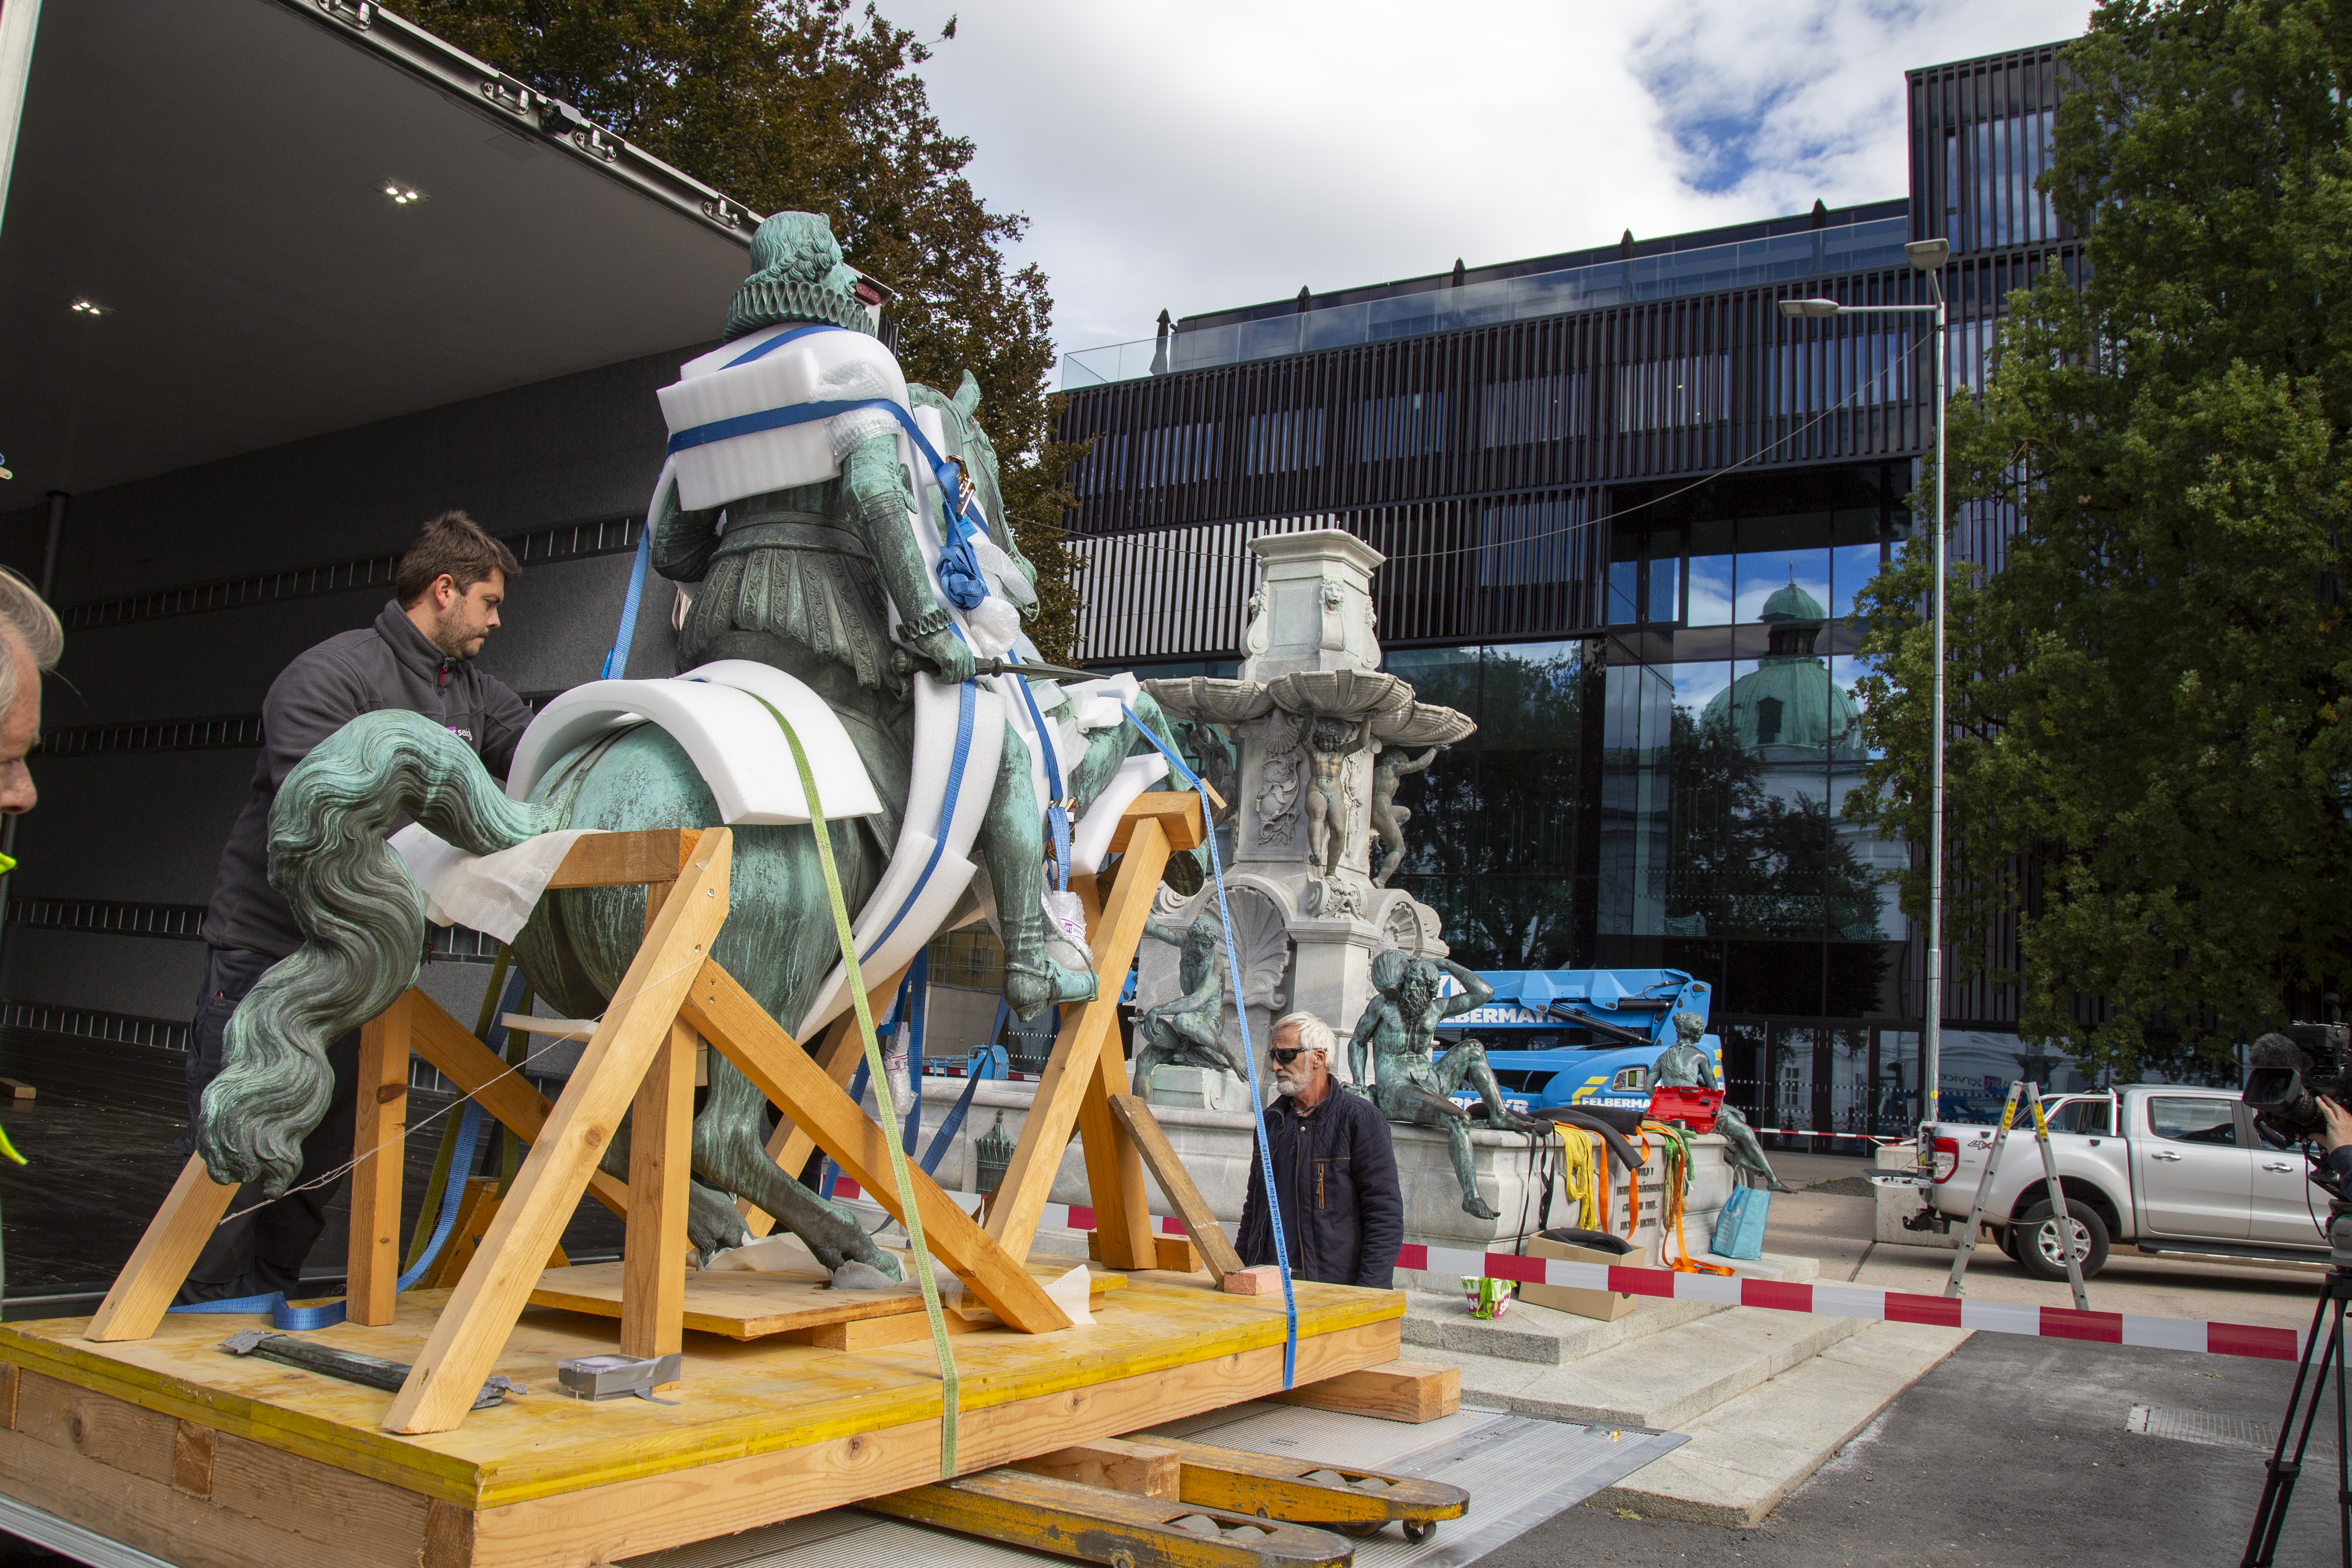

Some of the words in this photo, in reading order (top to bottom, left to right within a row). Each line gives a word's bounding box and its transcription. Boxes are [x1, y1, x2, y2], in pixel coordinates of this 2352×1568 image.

[1064, 924, 1073, 932] art
[1582, 1097, 1651, 1108] FELBERMA
[1262, 1144, 1274, 1183] gmbh
[1269, 1187, 1281, 1235] austria
[1278, 1237, 1291, 1288] service
[1287, 1292, 1295, 1311] art
[1289, 1315, 1295, 1333] hs
